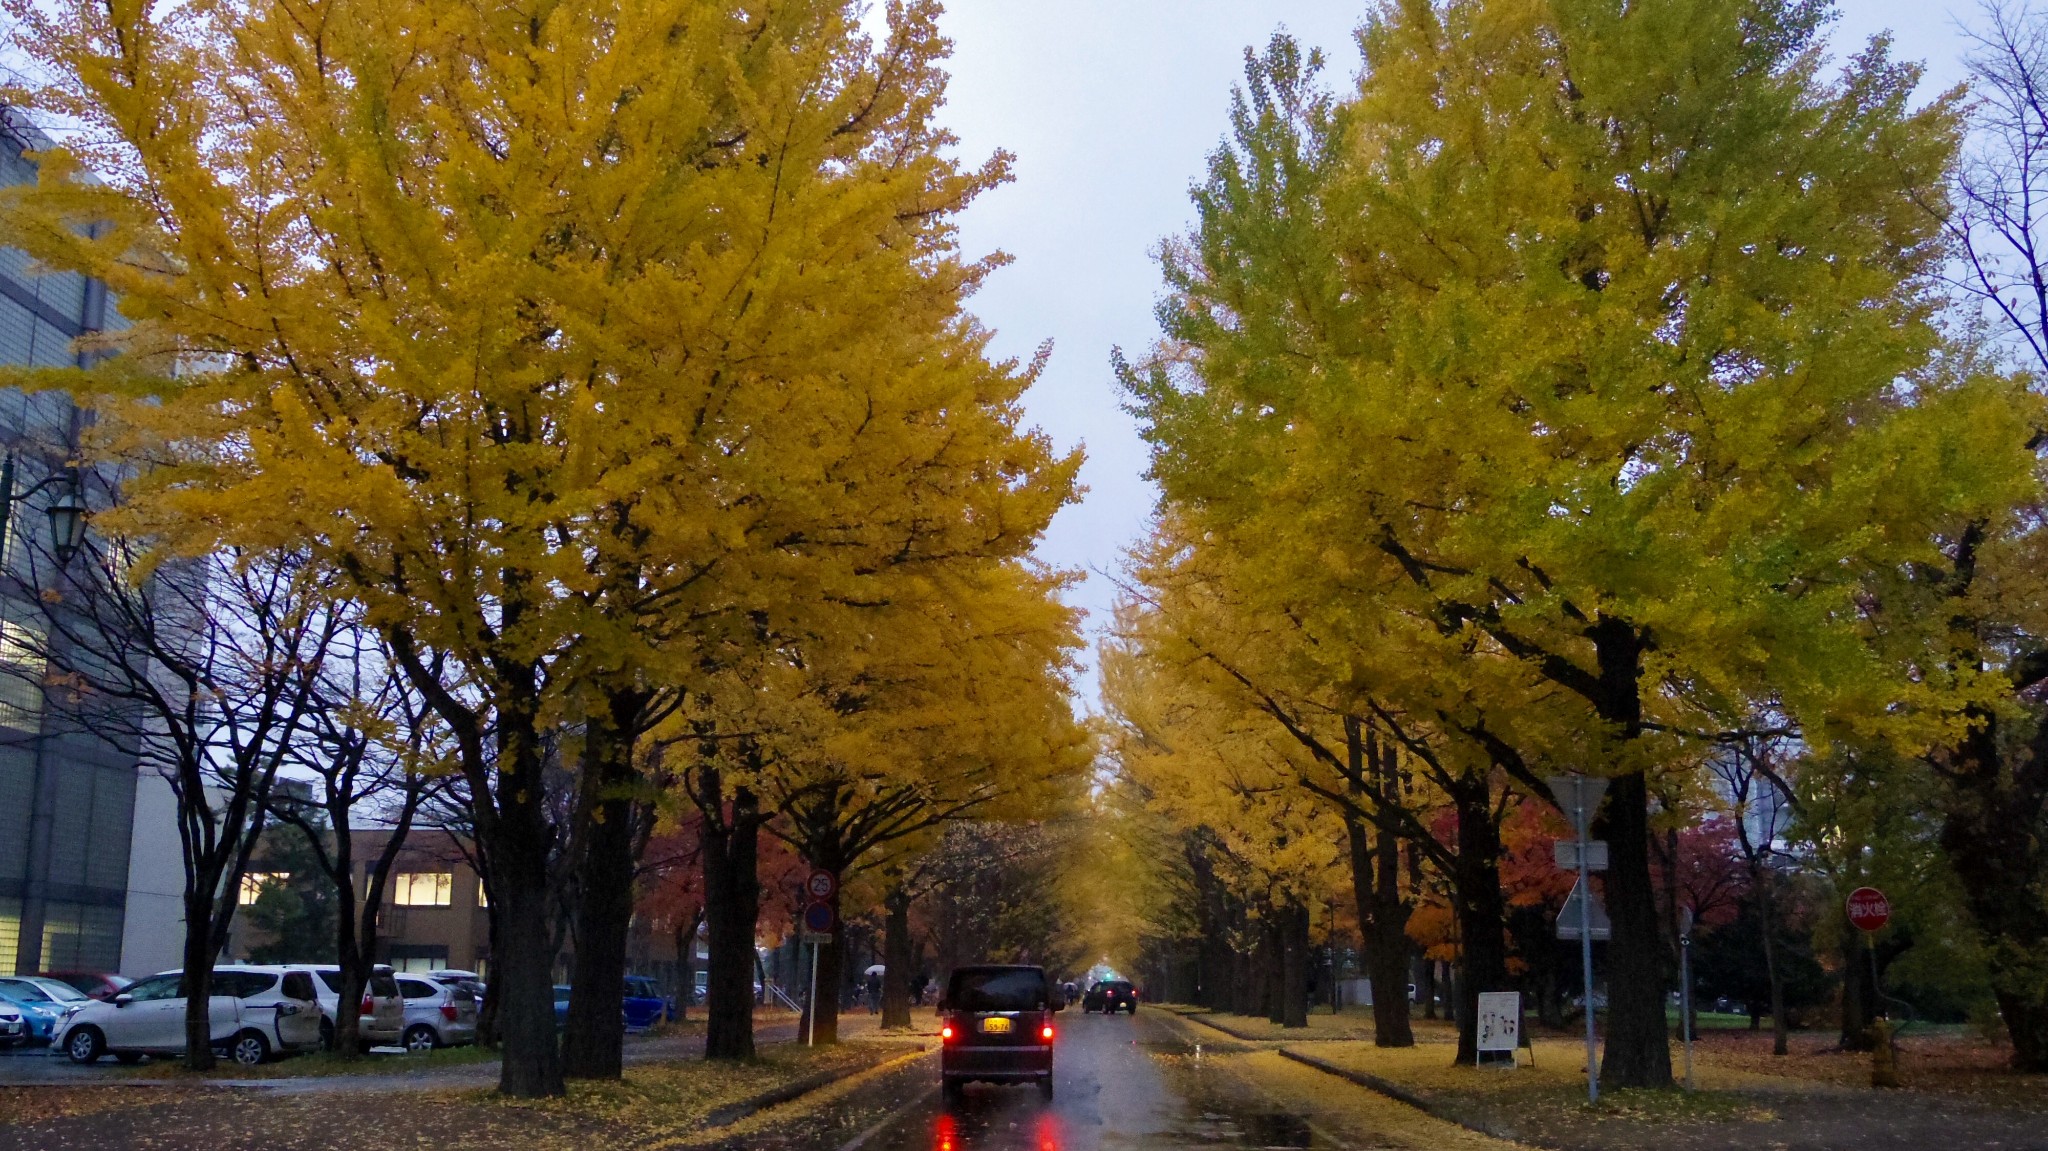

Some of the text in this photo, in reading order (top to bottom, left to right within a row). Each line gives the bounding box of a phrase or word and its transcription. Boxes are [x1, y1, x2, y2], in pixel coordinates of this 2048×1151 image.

[813, 878, 828, 892] 25
[1848, 901, 1888, 918] 消火栓
